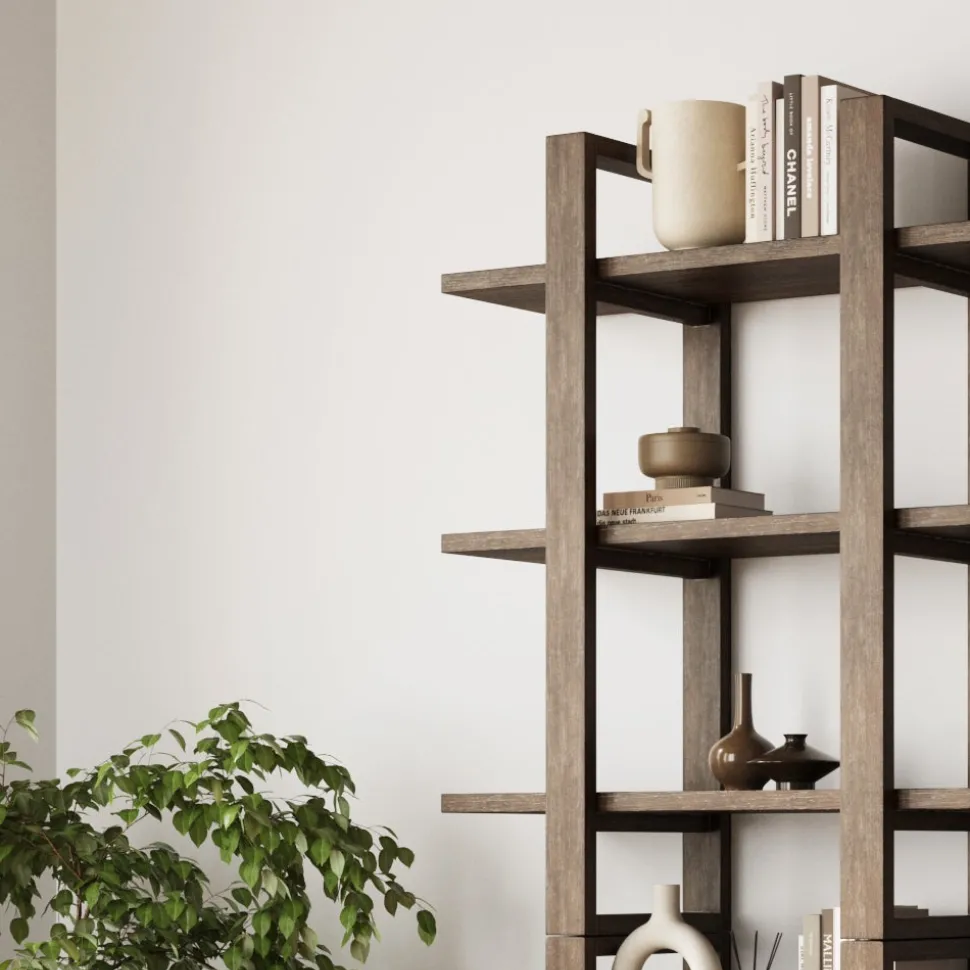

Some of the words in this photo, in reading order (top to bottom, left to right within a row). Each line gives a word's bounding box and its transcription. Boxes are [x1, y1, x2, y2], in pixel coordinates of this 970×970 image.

[787, 149, 797, 217] CHANEL
[611, 508, 628, 516] NEUE
[629, 506, 666, 515] FRANKFURT
